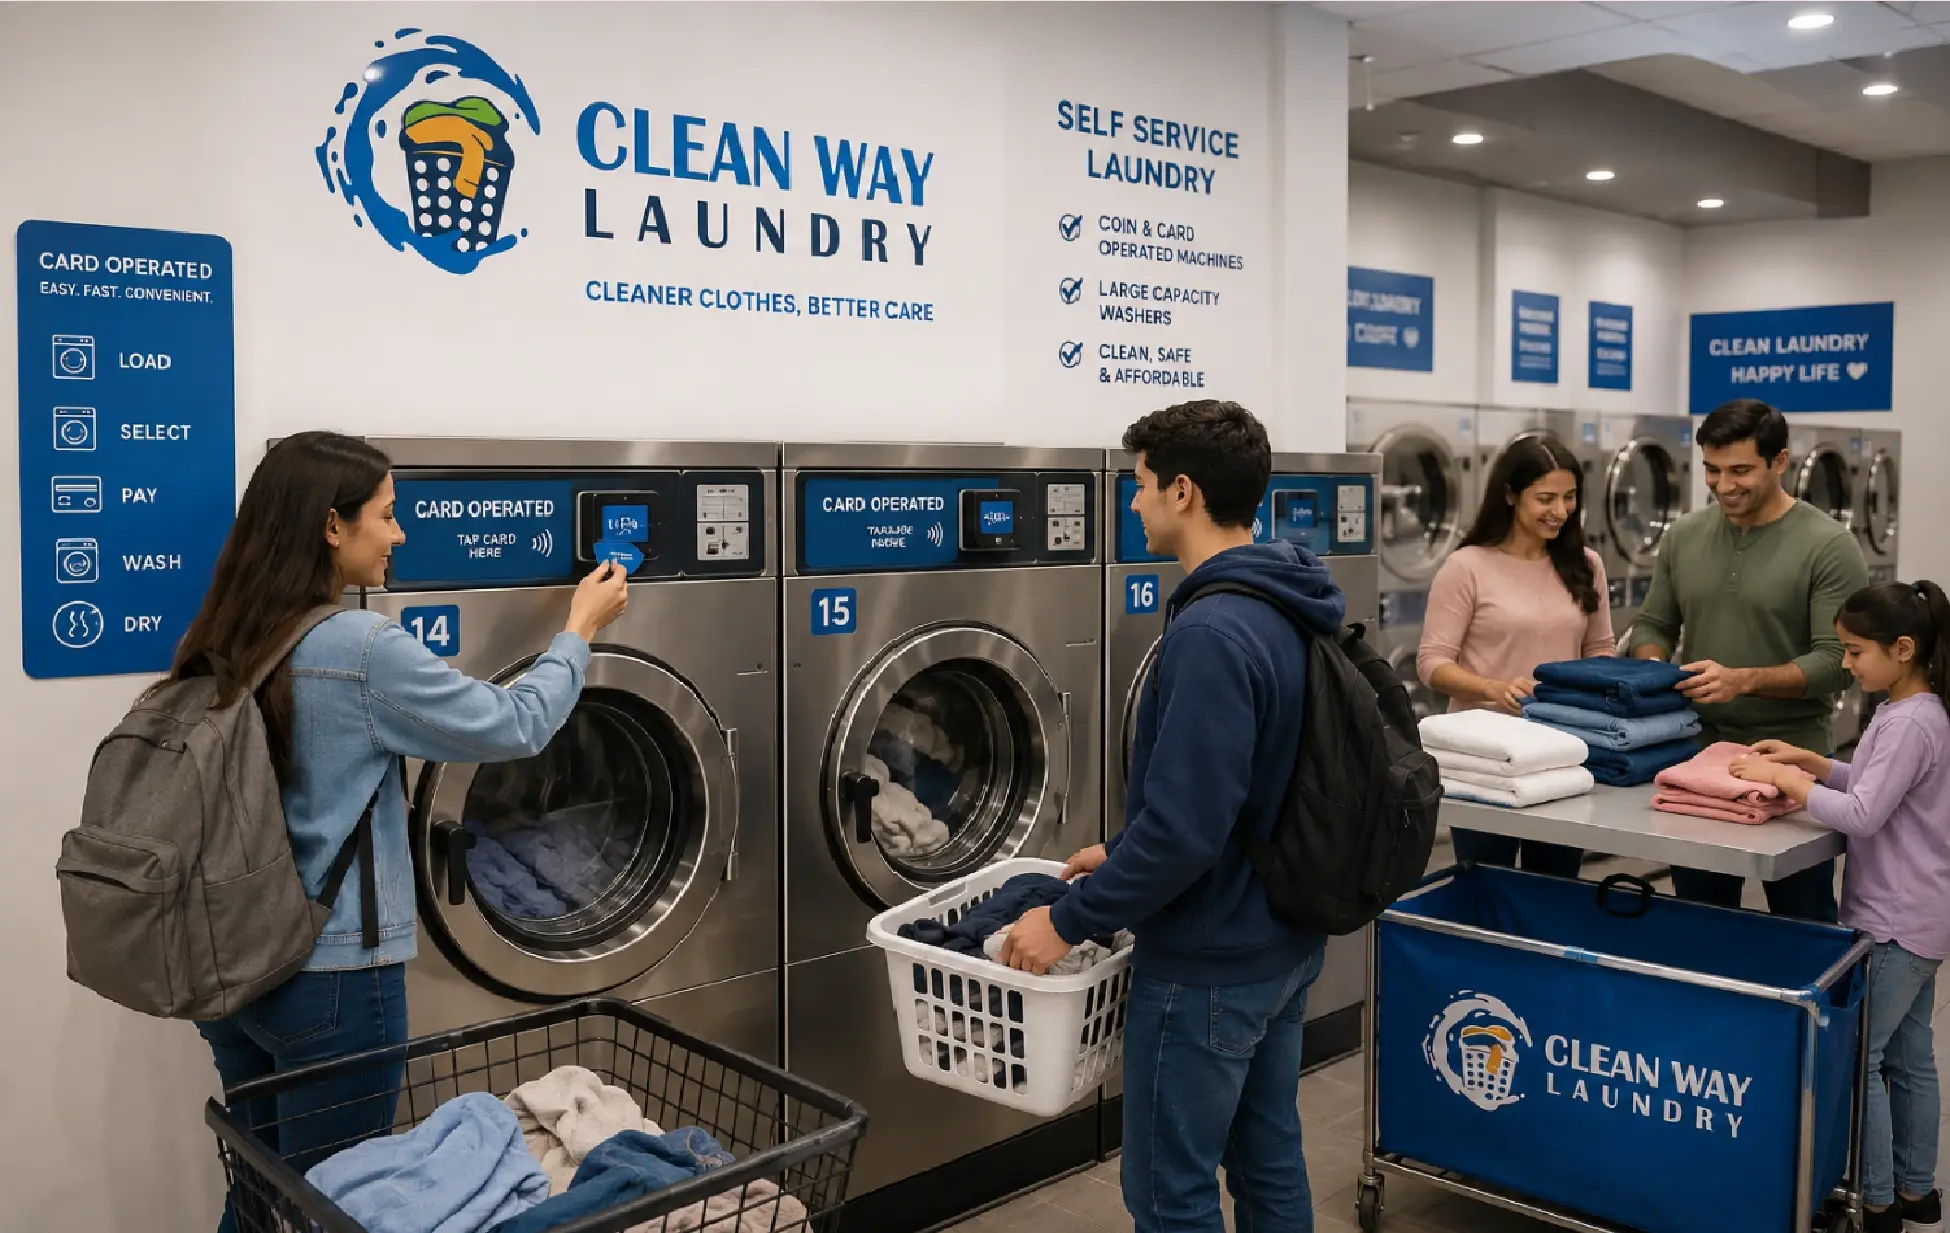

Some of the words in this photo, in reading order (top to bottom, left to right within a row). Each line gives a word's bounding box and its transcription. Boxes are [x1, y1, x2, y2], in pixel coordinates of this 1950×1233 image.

[1057, 100, 1124, 137] SELF
[1132, 114, 1239, 160] SERVICE
[577, 101, 791, 191] CLEAN
[813, 135, 934, 206] WAY
[1087, 149, 1216, 195] LAUNDRY
[584, 188, 932, 266] LAUNDRY
[1099, 215, 1137, 235] COIN
[1141, 219, 1153, 238] &
[1156, 222, 1195, 242] CARD
[39, 251, 100, 273] CARD
[104, 256, 213, 279] OPERATED
[1099, 240, 1173, 262] OPERATED
[1177, 248, 1243, 271] MACHINES
[39, 281, 80, 297] EASY.
[83, 284, 121, 299] FAST.
[125, 287, 213, 304] CONVENIENT.
[586, 280, 693, 307] CLEANER
[699, 288, 801, 317] CLOTHES,
[808, 295, 880, 319] BETTER
[884, 300, 934, 321] CARE
[1099, 280, 1149, 301] LARGE
[1153, 285, 1220, 306] CAPACITY
[1099, 304, 1172, 325] WASHERS
[1099, 343, 1153, 364] CLEAN,
[1157, 346, 1192, 364] SAFE
[1709, 337, 1771, 357] CLEAN
[1775, 333, 1870, 355] LAUNDRY
[118, 351, 172, 371] LOAD
[1731, 365, 1795, 384] HAPPY
[1799, 362, 1840, 383] LIFE
[1099, 366, 1111, 383] &
[1114, 367, 1204, 388] AFFORDABLE
[120, 423, 192, 441] SELECT
[121, 487, 158, 503] PAY
[822, 496, 866, 513] CARD
[870, 496, 945, 513] OPERATED
[414, 500, 465, 519] CARD
[466, 499, 554, 518] OPERATED
[483, 533, 516, 546] CARD
[122, 554, 181, 572] WASH
[468, 546, 502, 558] HERE
[1130, 582, 1154, 608] 16
[818, 595, 850, 626] 15
[124, 615, 162, 633] DRY
[410, 615, 450, 646] 14
[1544, 1035, 1660, 1089] CLEAN
[1671, 1060, 1753, 1107] WAY
[1546, 1072, 1744, 1139] LAUNDRY
